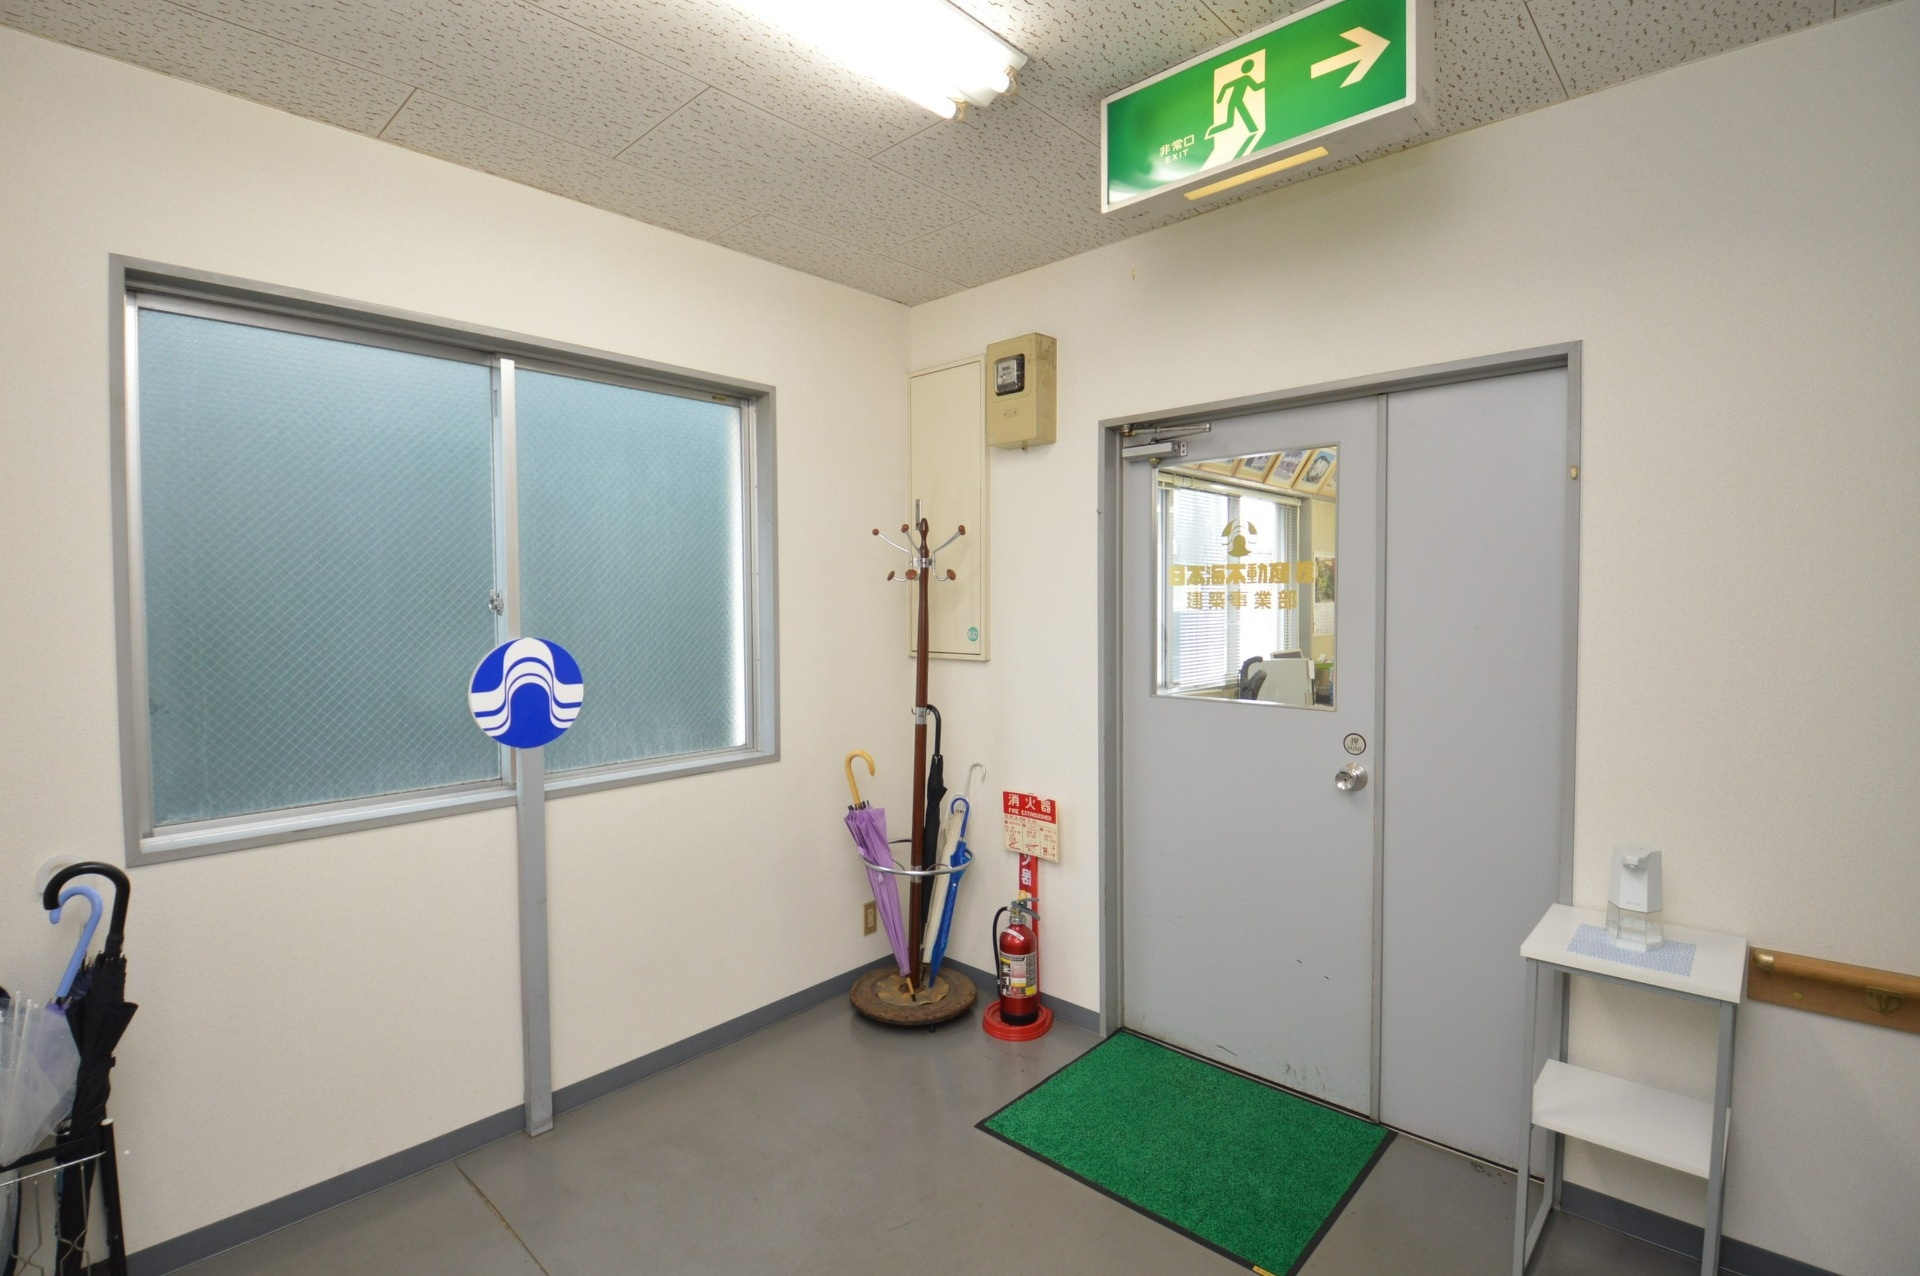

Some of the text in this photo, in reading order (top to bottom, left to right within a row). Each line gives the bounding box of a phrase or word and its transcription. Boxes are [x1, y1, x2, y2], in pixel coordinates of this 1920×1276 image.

[1160, 134, 1194, 158] 非常口
[1166, 149, 1189, 164] EXIT
[1187, 590, 1297, 610] 建築事業部
[1008, 793, 1051, 813] 消火器
